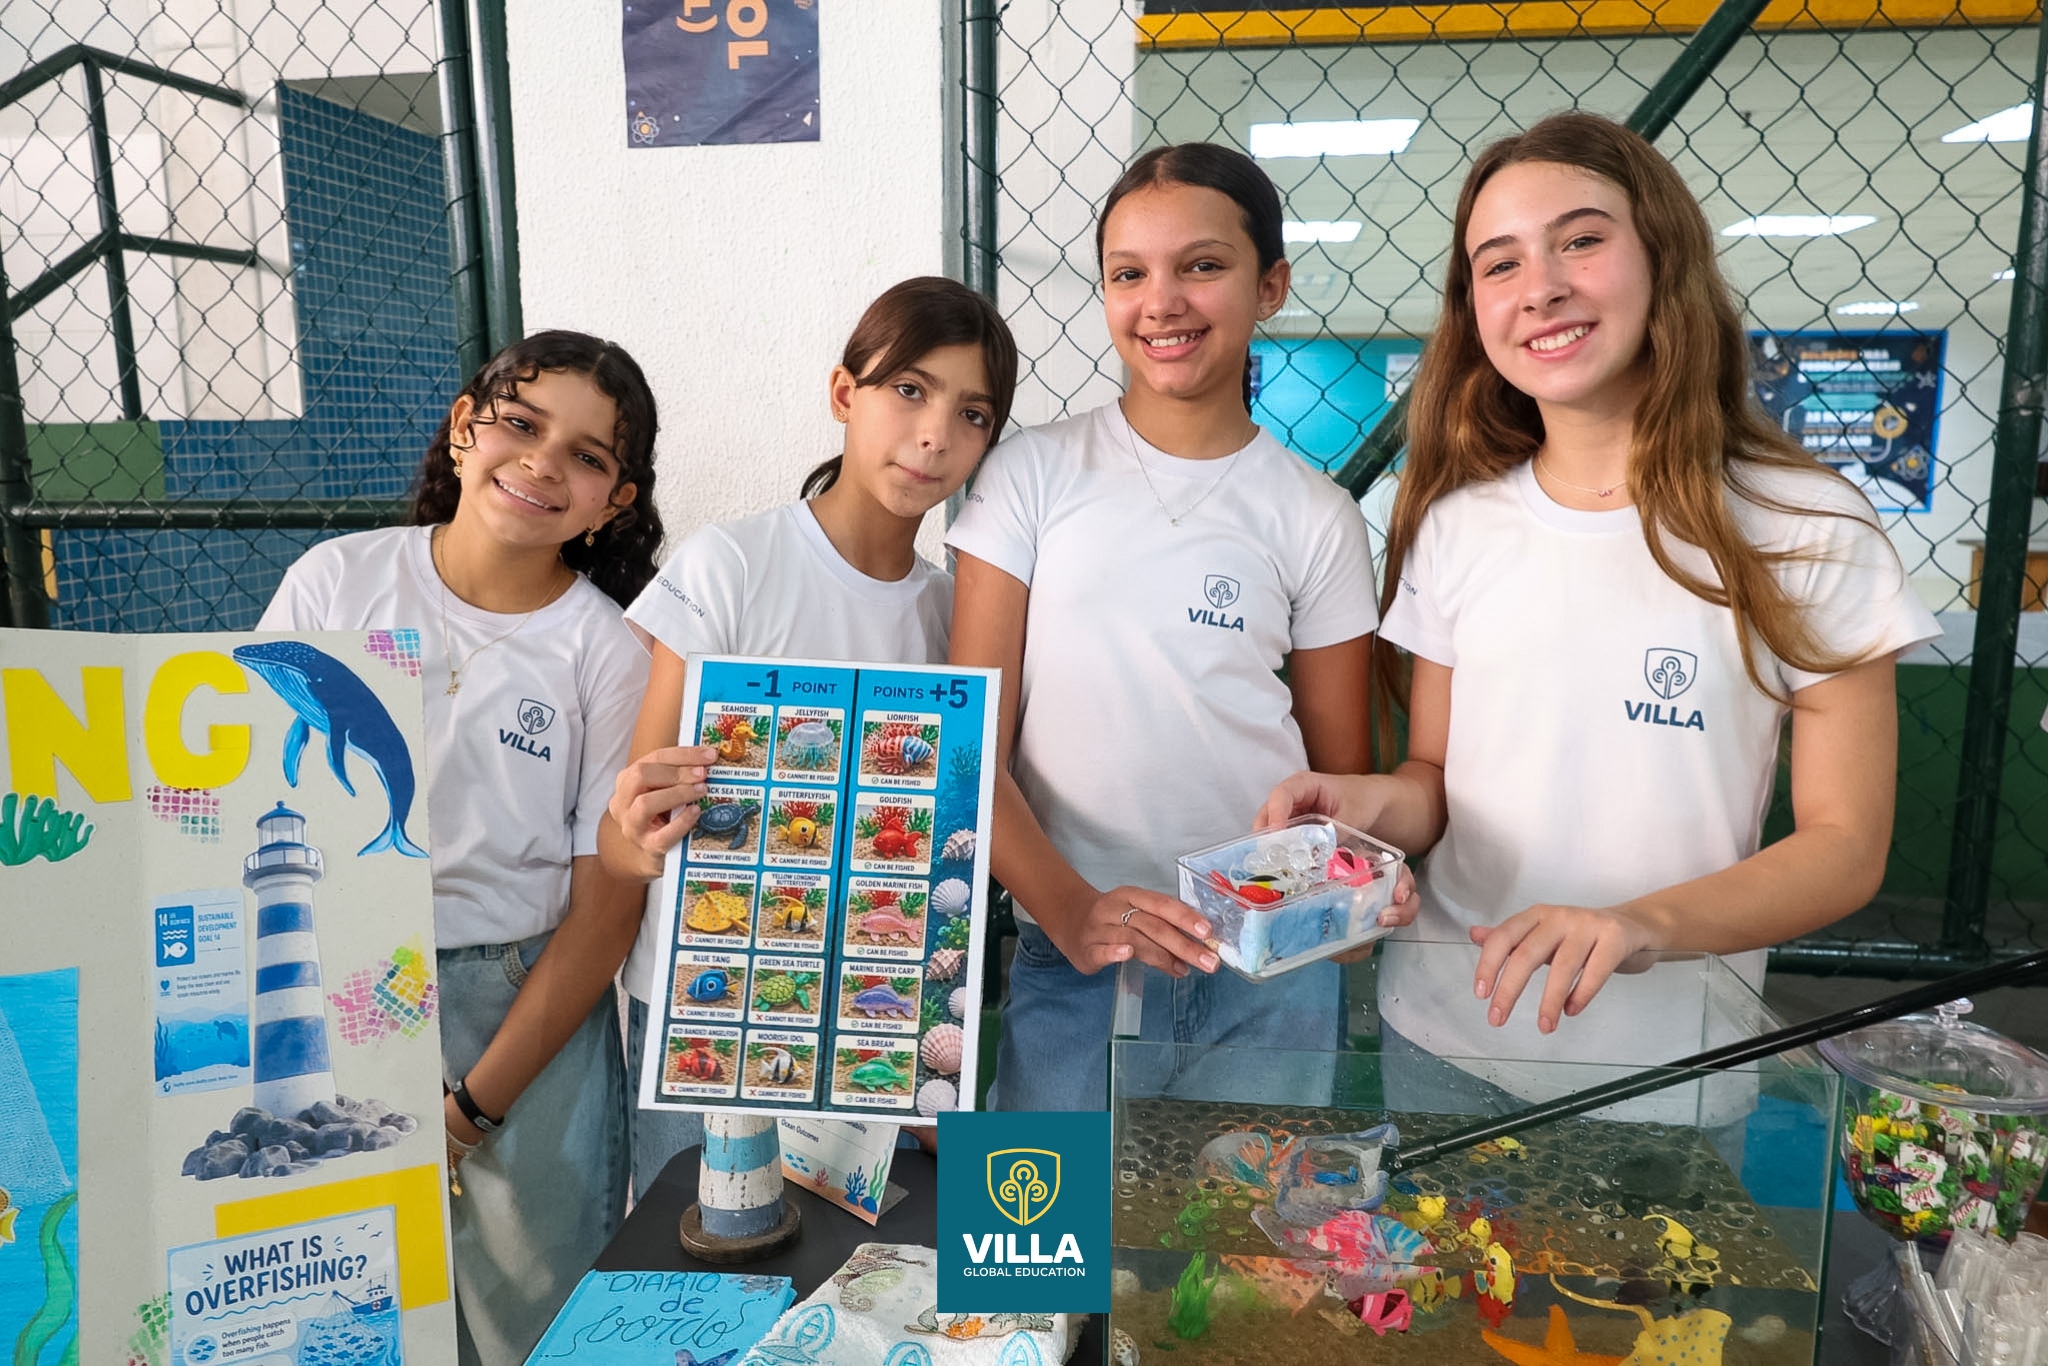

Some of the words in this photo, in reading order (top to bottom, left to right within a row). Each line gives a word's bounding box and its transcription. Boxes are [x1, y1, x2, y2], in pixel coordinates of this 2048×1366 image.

[657, 575, 705, 618] EDUCATION
[1188, 607, 1244, 633] VILLA
[792, 682, 837, 694] POINT
[873, 686, 924, 699] POINTS
[929, 678, 968, 709] +5
[721, 705, 757, 713] SEAHORSE
[795, 709, 829, 717] JELLYFISH
[887, 713, 919, 722] LIONFISH
[1624, 700, 1705, 731] VILLA
[499, 728, 551, 762] VILLA
[707, 787, 719, 795] ACK
[735, 788, 760, 797] TURTLE
[778, 791, 830, 800] BUTTERFLYFISH
[879, 796, 912, 805] GOLDFISH
[687, 871, 728, 880] BLUE-SPOTTED
[882, 881, 907, 889] MARINE
[158, 913, 168, 927] 14
[198, 912, 234, 921] SUSTAINABLE
[198, 922, 237, 932] DEVELOPMENT
[198, 935, 213, 943] GOAL
[693, 955, 710, 963] BLUE
[711, 956, 731, 964] TANG
[796, 960, 820, 969] TURTLE
[849, 964, 874, 973] MARINE
[875, 966, 896, 974] SILVER
[898, 967, 916, 975] CARP
[757, 1033, 788, 1041] MOORISH
[790, 1034, 804, 1043] IDOL
[857, 1039, 870, 1047] SEA
[871, 1040, 895, 1048] BREAM
[781, 1118, 796, 1131] Ocean
[796, 1125, 820, 1143] Outcomes
[224, 1240, 294, 1275] WHAT
[302, 1235, 323, 1257] IS
[185, 1254, 367, 1316] OVERFISHING?
[659, 1293, 704, 1314] de
[221, 1324, 262, 1340] Overfishing
[262, 1318, 291, 1330] happens
[222, 1339, 241, 1348] when
[242, 1333, 265, 1345] people
[266, 1329, 285, 1338] catch
[222, 1350, 234, 1358] too
[235, 1346, 255, 1355] many
